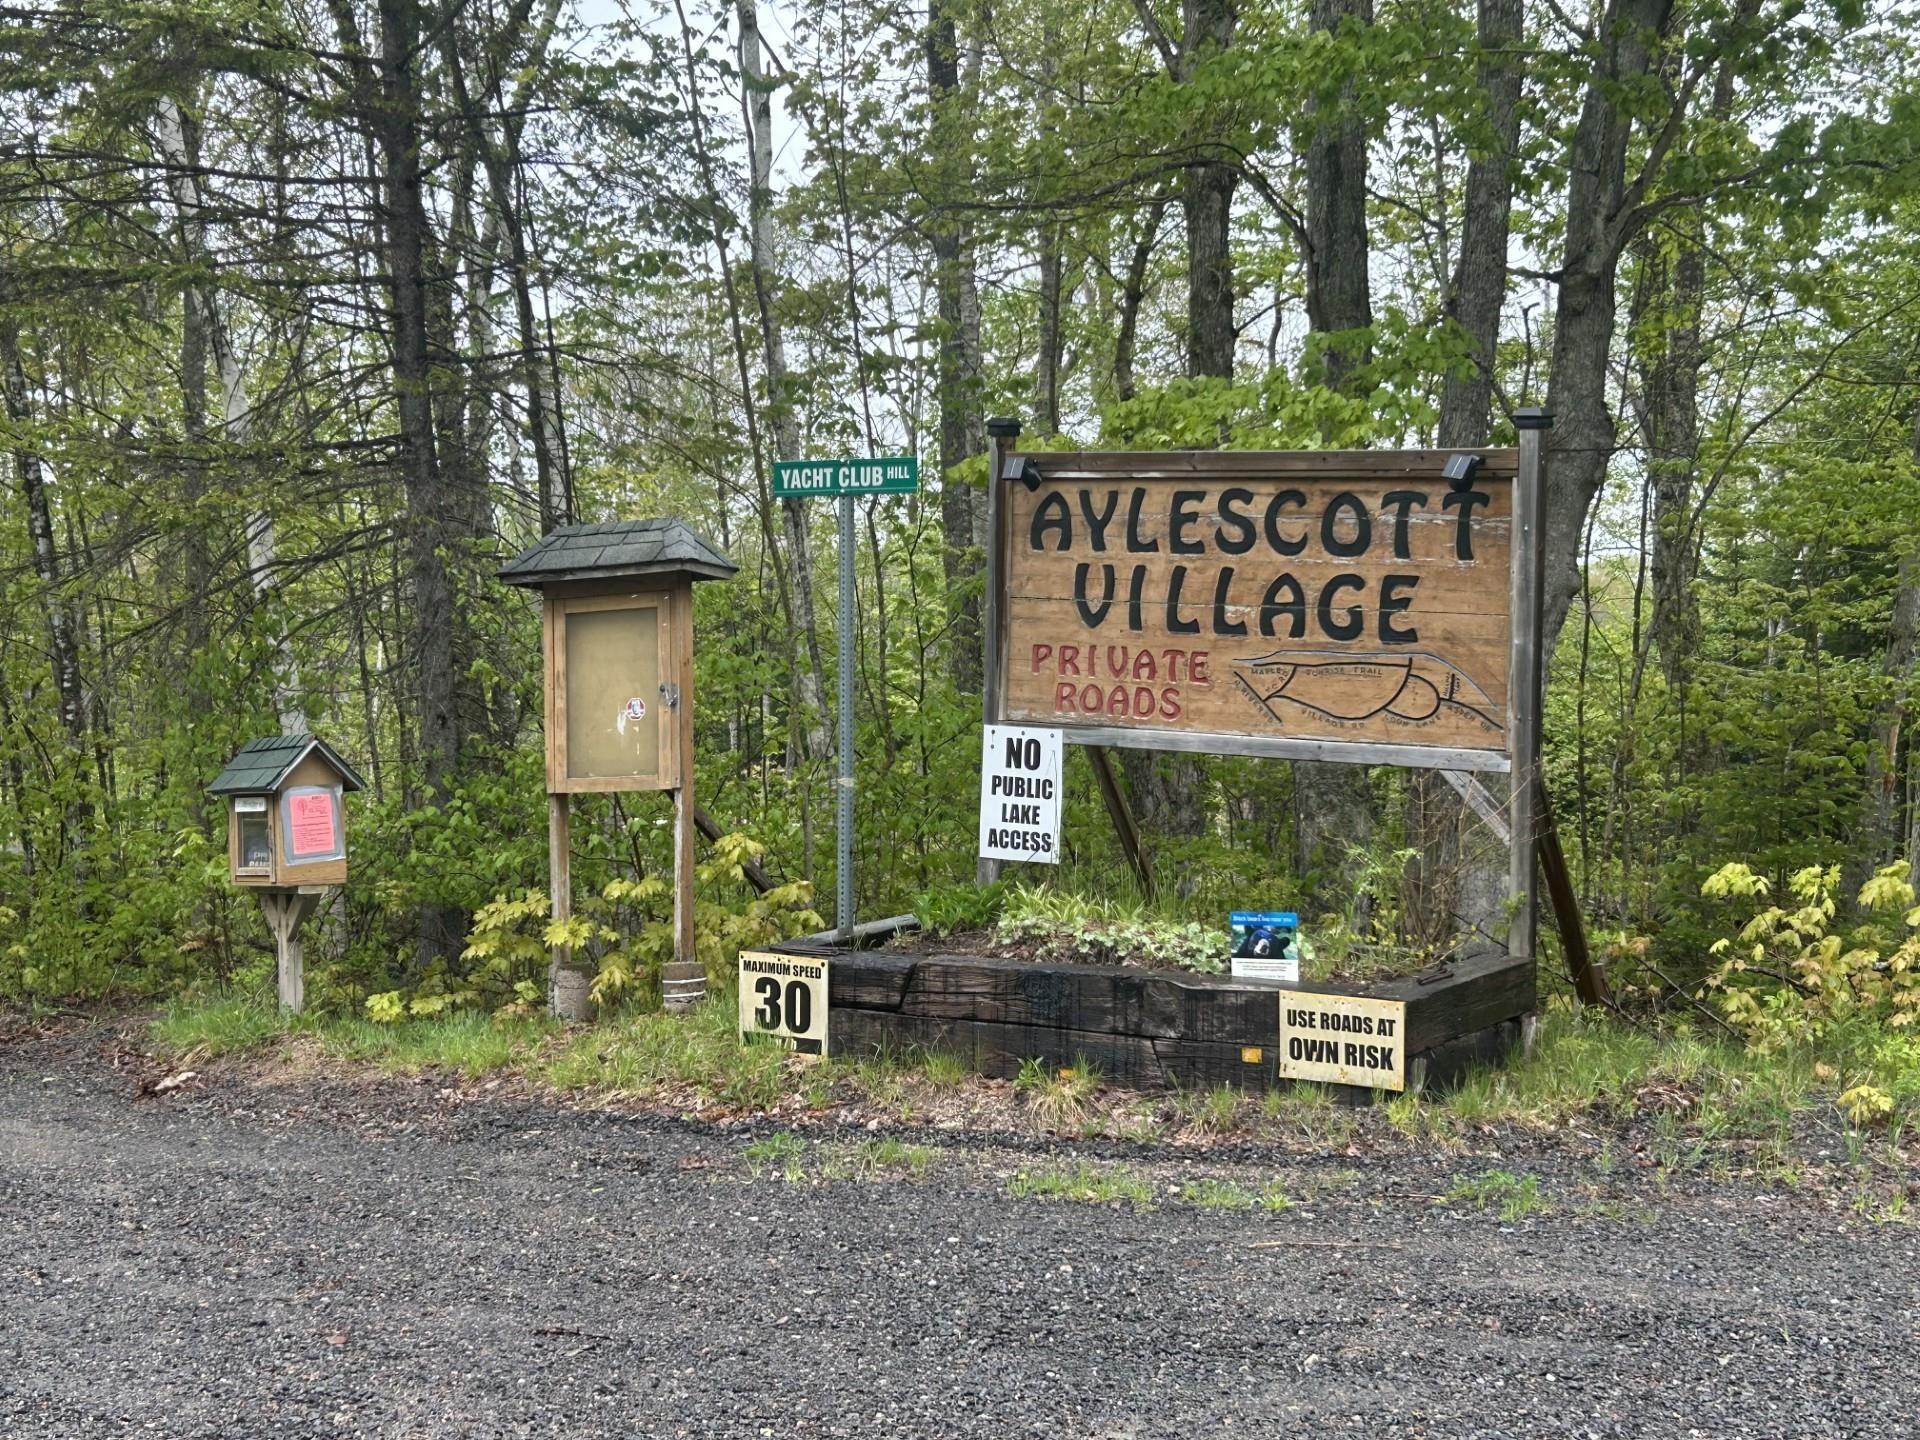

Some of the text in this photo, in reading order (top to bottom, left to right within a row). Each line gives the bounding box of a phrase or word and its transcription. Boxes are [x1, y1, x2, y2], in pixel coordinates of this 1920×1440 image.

[781, 466, 910, 489] YACHT CLUB HILL
[1030, 487, 1490, 562] AYLESCOTT
[1074, 563, 1420, 643] VILLAGE
[1031, 644, 1210, 684] PRIVATE
[1353, 666, 1383, 676] TRAIL
[1054, 681, 1183, 721] ROADS
[1302, 708, 1345, 729] VILLAGE
[1005, 737, 1042, 770] NO
[991, 775, 1053, 800] PUBLIC
[1001, 803, 1041, 825] LAKE
[987, 828, 1052, 853] ACCESS
[743, 960, 822, 980] MAXIMUM SPEED
[755, 977, 811, 1034] 30
[1287, 1008, 1397, 1037] USE ROADS AT
[1289, 1036, 1395, 1071] OWN RISK
